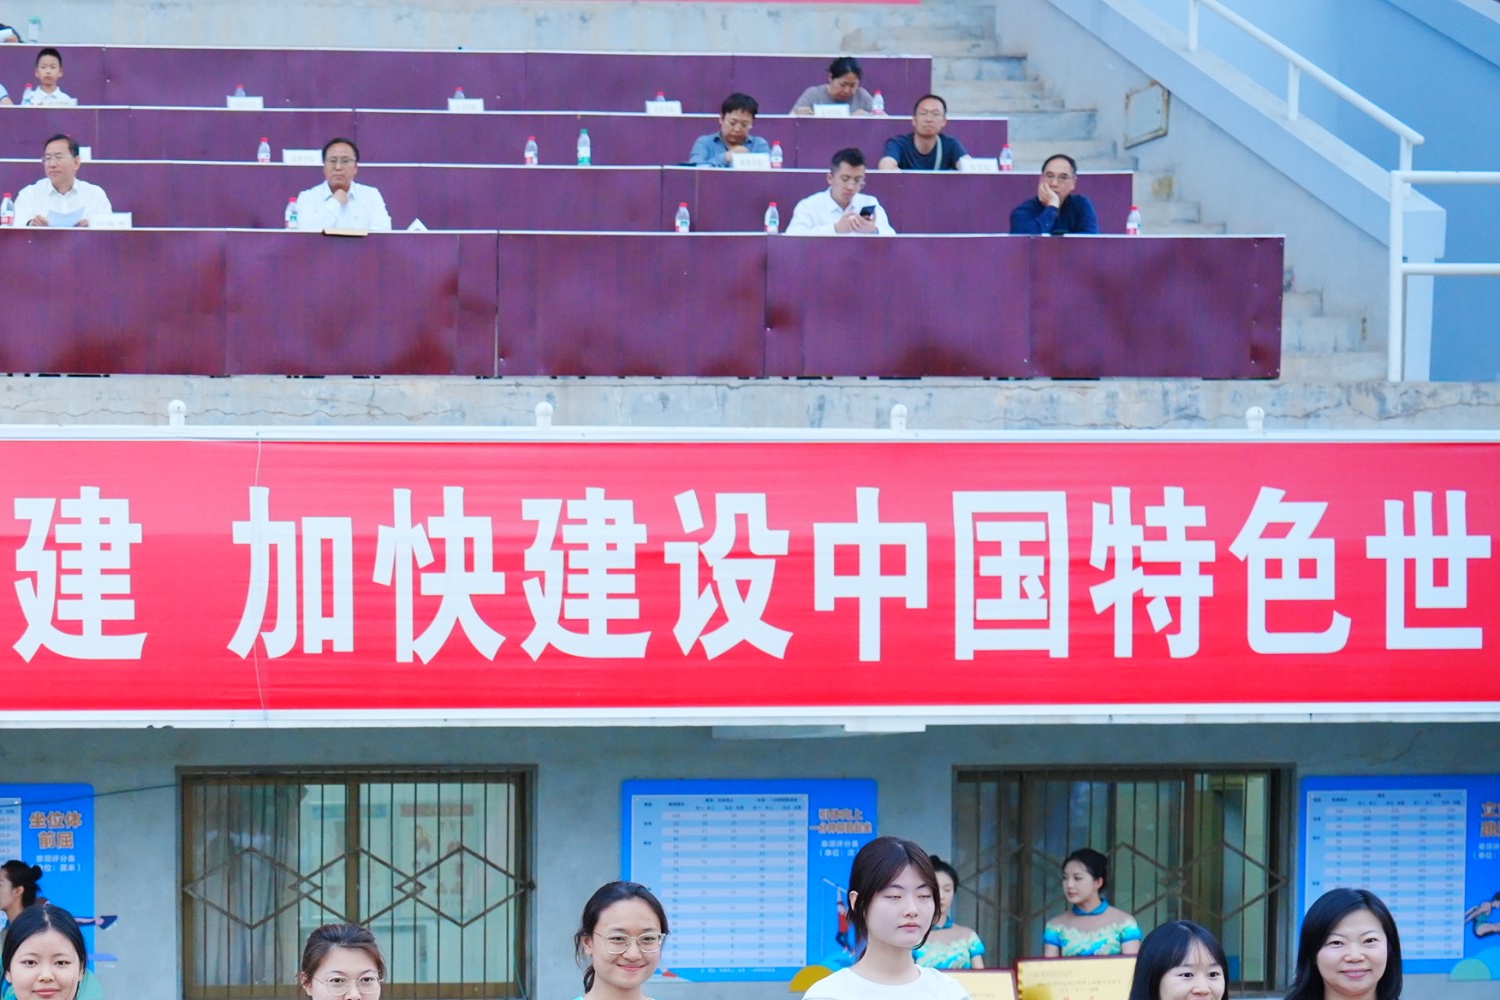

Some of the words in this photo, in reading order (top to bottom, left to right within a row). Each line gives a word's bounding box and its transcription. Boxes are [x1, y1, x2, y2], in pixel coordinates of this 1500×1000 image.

[227, 486, 1492, 664] 加快建设中国特色世
[29, 811, 83, 829] 坐位体
[38, 831, 74, 849] 前屈
[36, 855, 76, 863] 单项评分表
